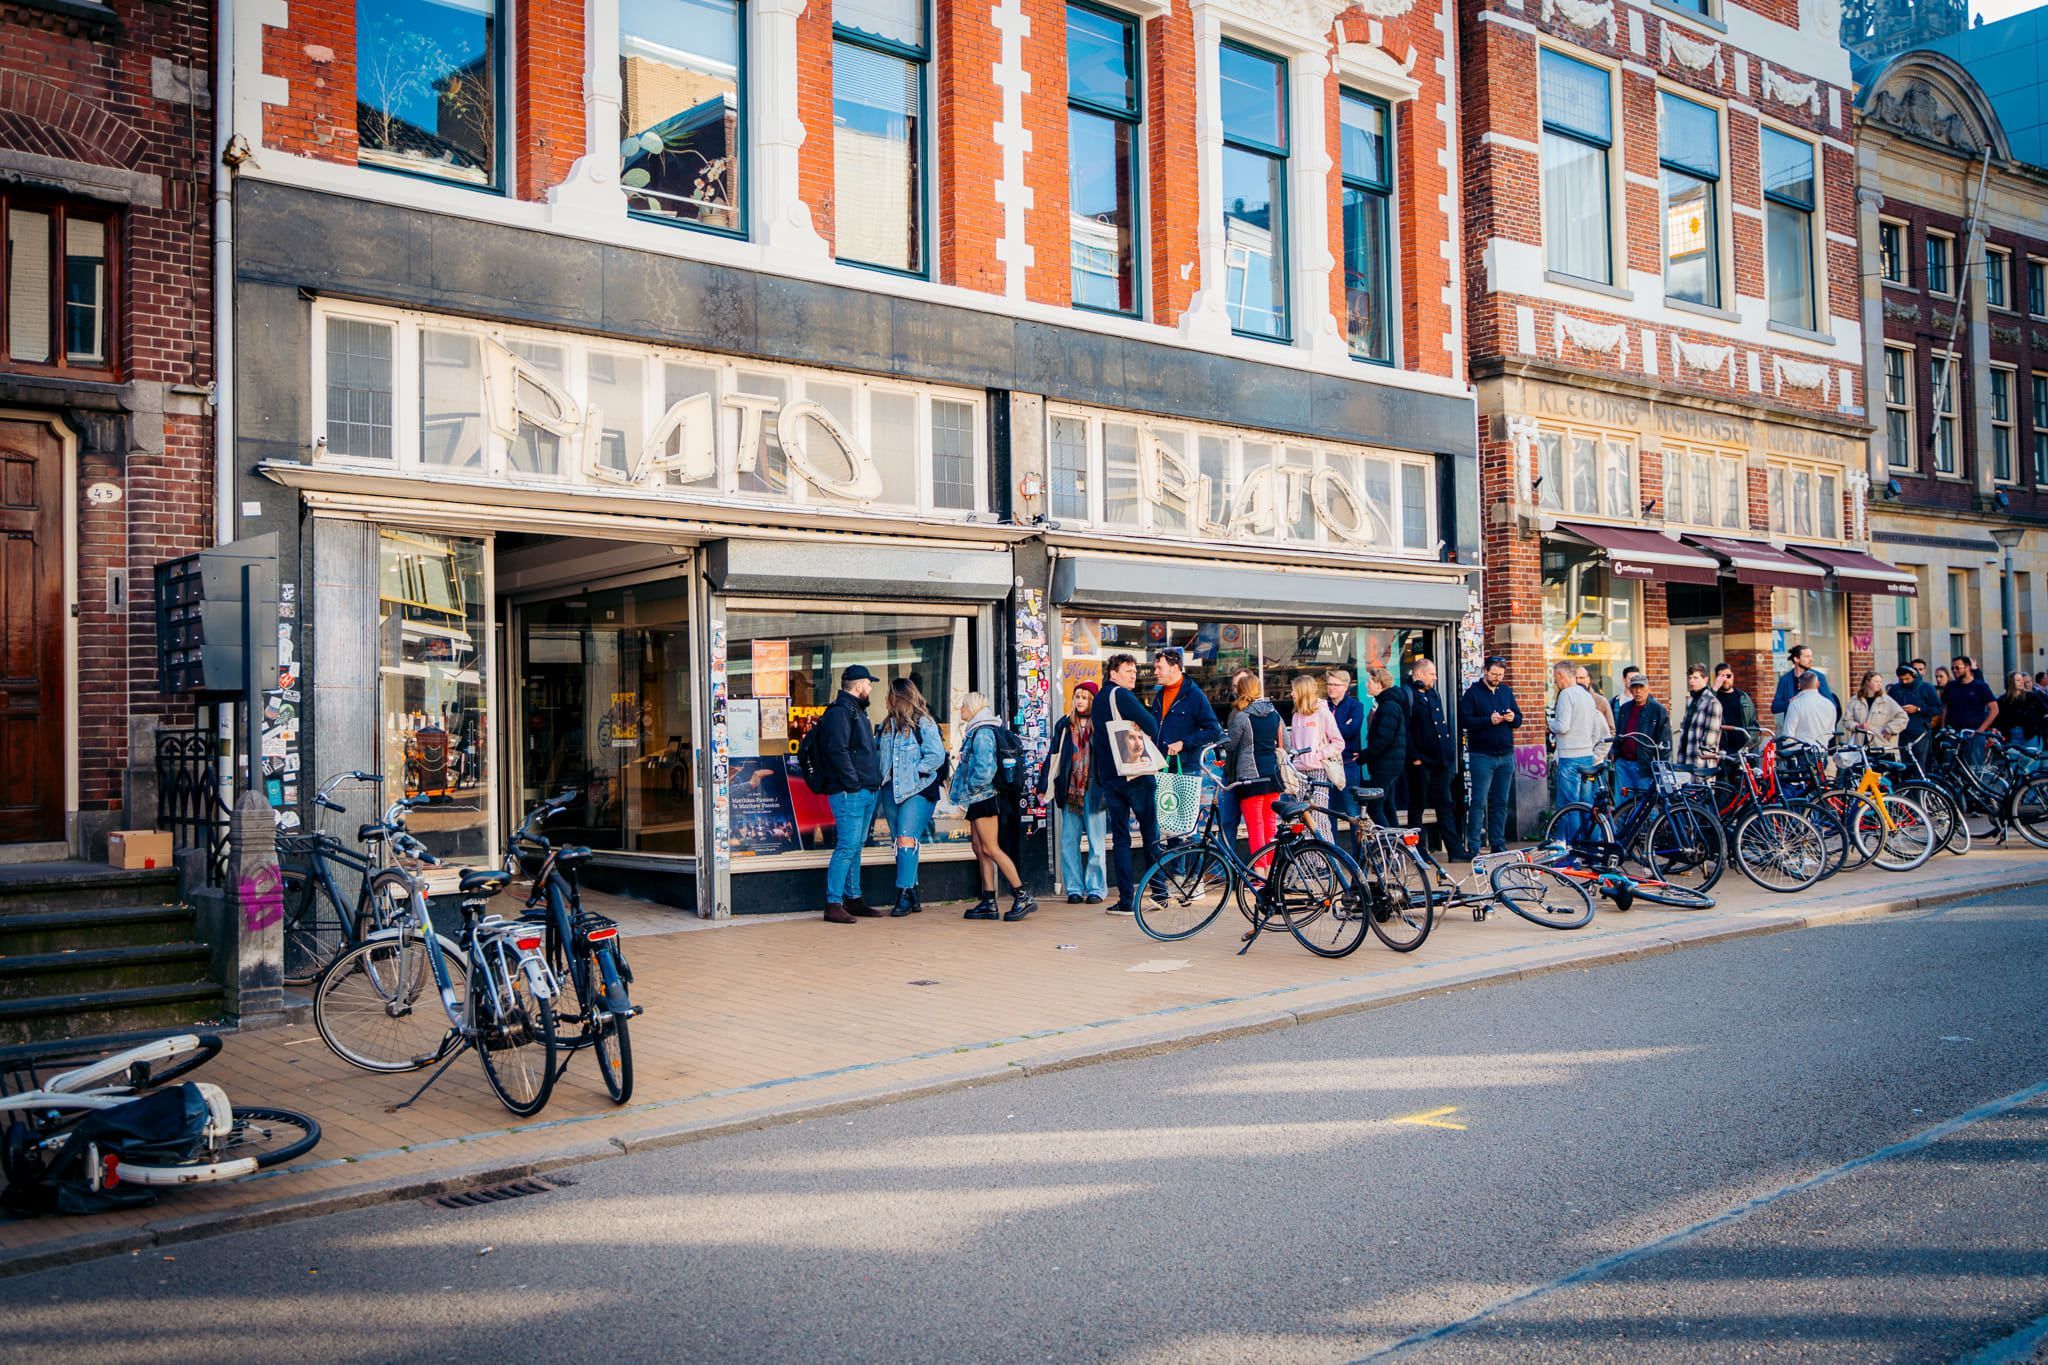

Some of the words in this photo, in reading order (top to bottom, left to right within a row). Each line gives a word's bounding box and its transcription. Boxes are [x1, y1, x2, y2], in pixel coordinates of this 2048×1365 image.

[480, 336, 883, 500] PLATO
[1538, 386, 1639, 426] KLEEDING
[1768, 426, 1806, 455] NAAR
[1810, 432, 1845, 461] MAAT
[1137, 424, 1376, 544] PLATO
